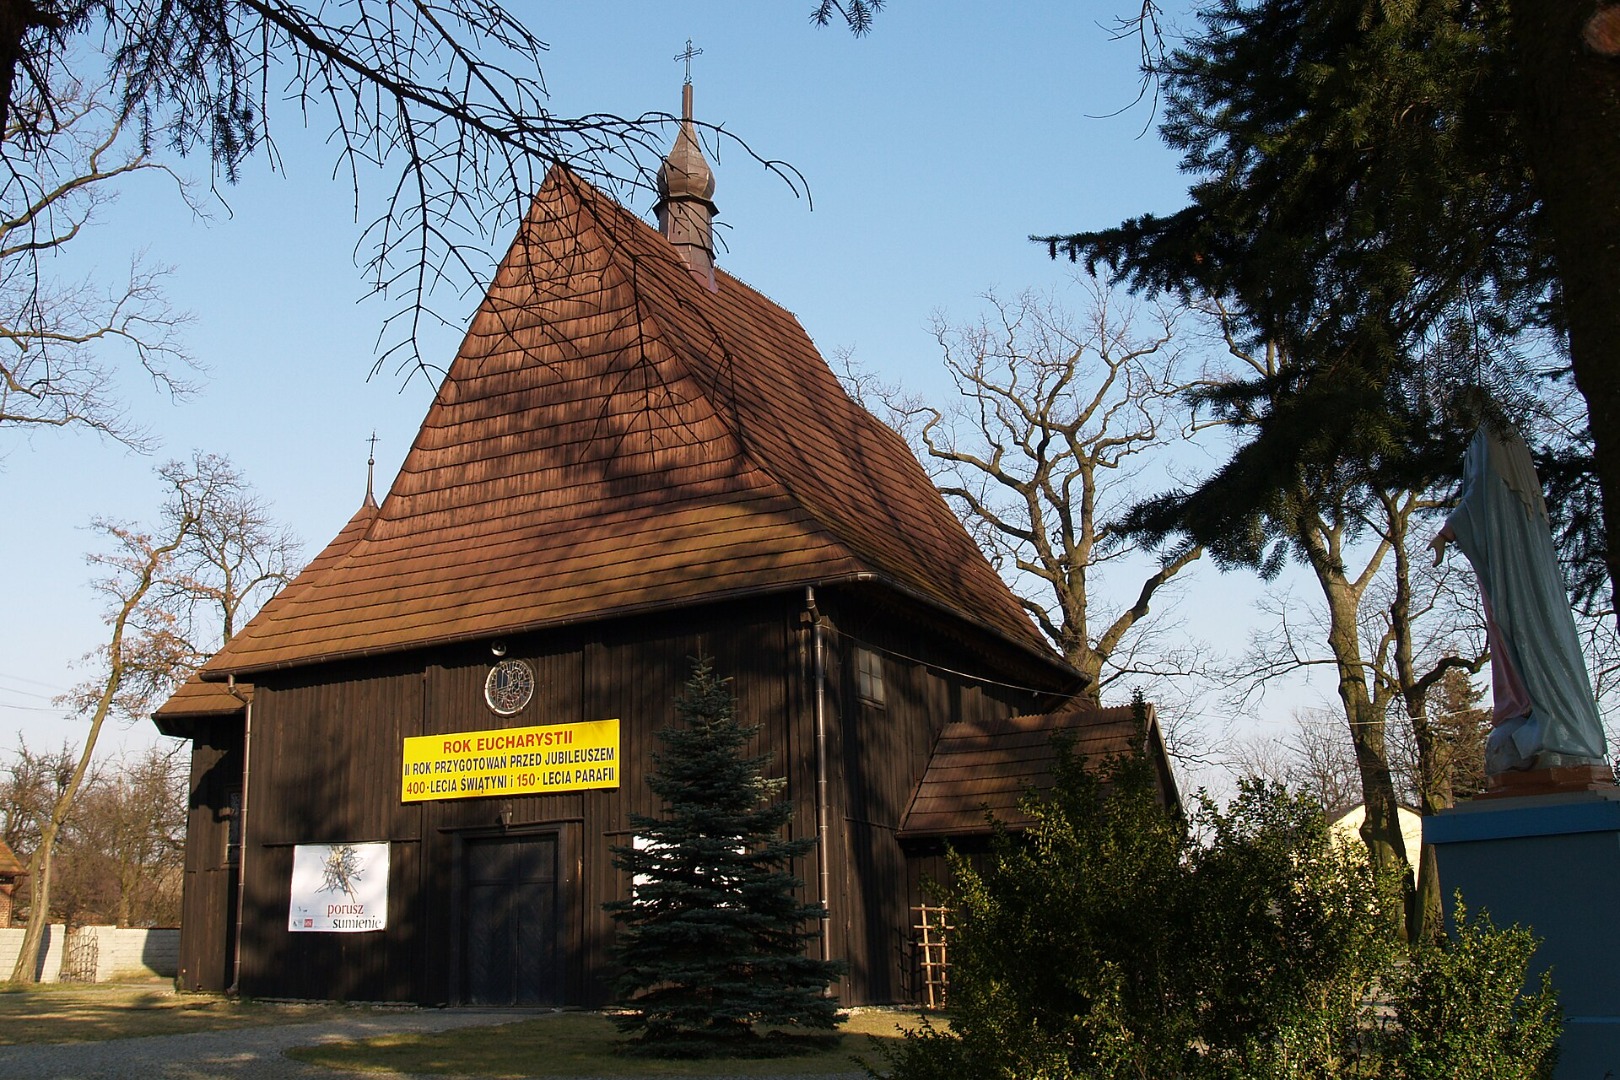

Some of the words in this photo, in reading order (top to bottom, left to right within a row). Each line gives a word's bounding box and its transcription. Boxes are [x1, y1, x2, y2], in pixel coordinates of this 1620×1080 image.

[443, 739, 471, 754] ROK
[477, 731, 572, 751] EUCHARYSTII
[405, 763, 409, 775] II
[413, 761, 431, 774] ROK
[435, 752, 506, 773] PRZYGOTOWAŃ
[510, 753, 541, 768] PRZED
[545, 747, 614, 765] JUBILEUSZEM
[460, 774, 506, 793] ŚWIĄTYNI
[543, 771, 571, 785] LECIA
[575, 768, 614, 782] PARAFII
[327, 904, 364, 917] porusz
